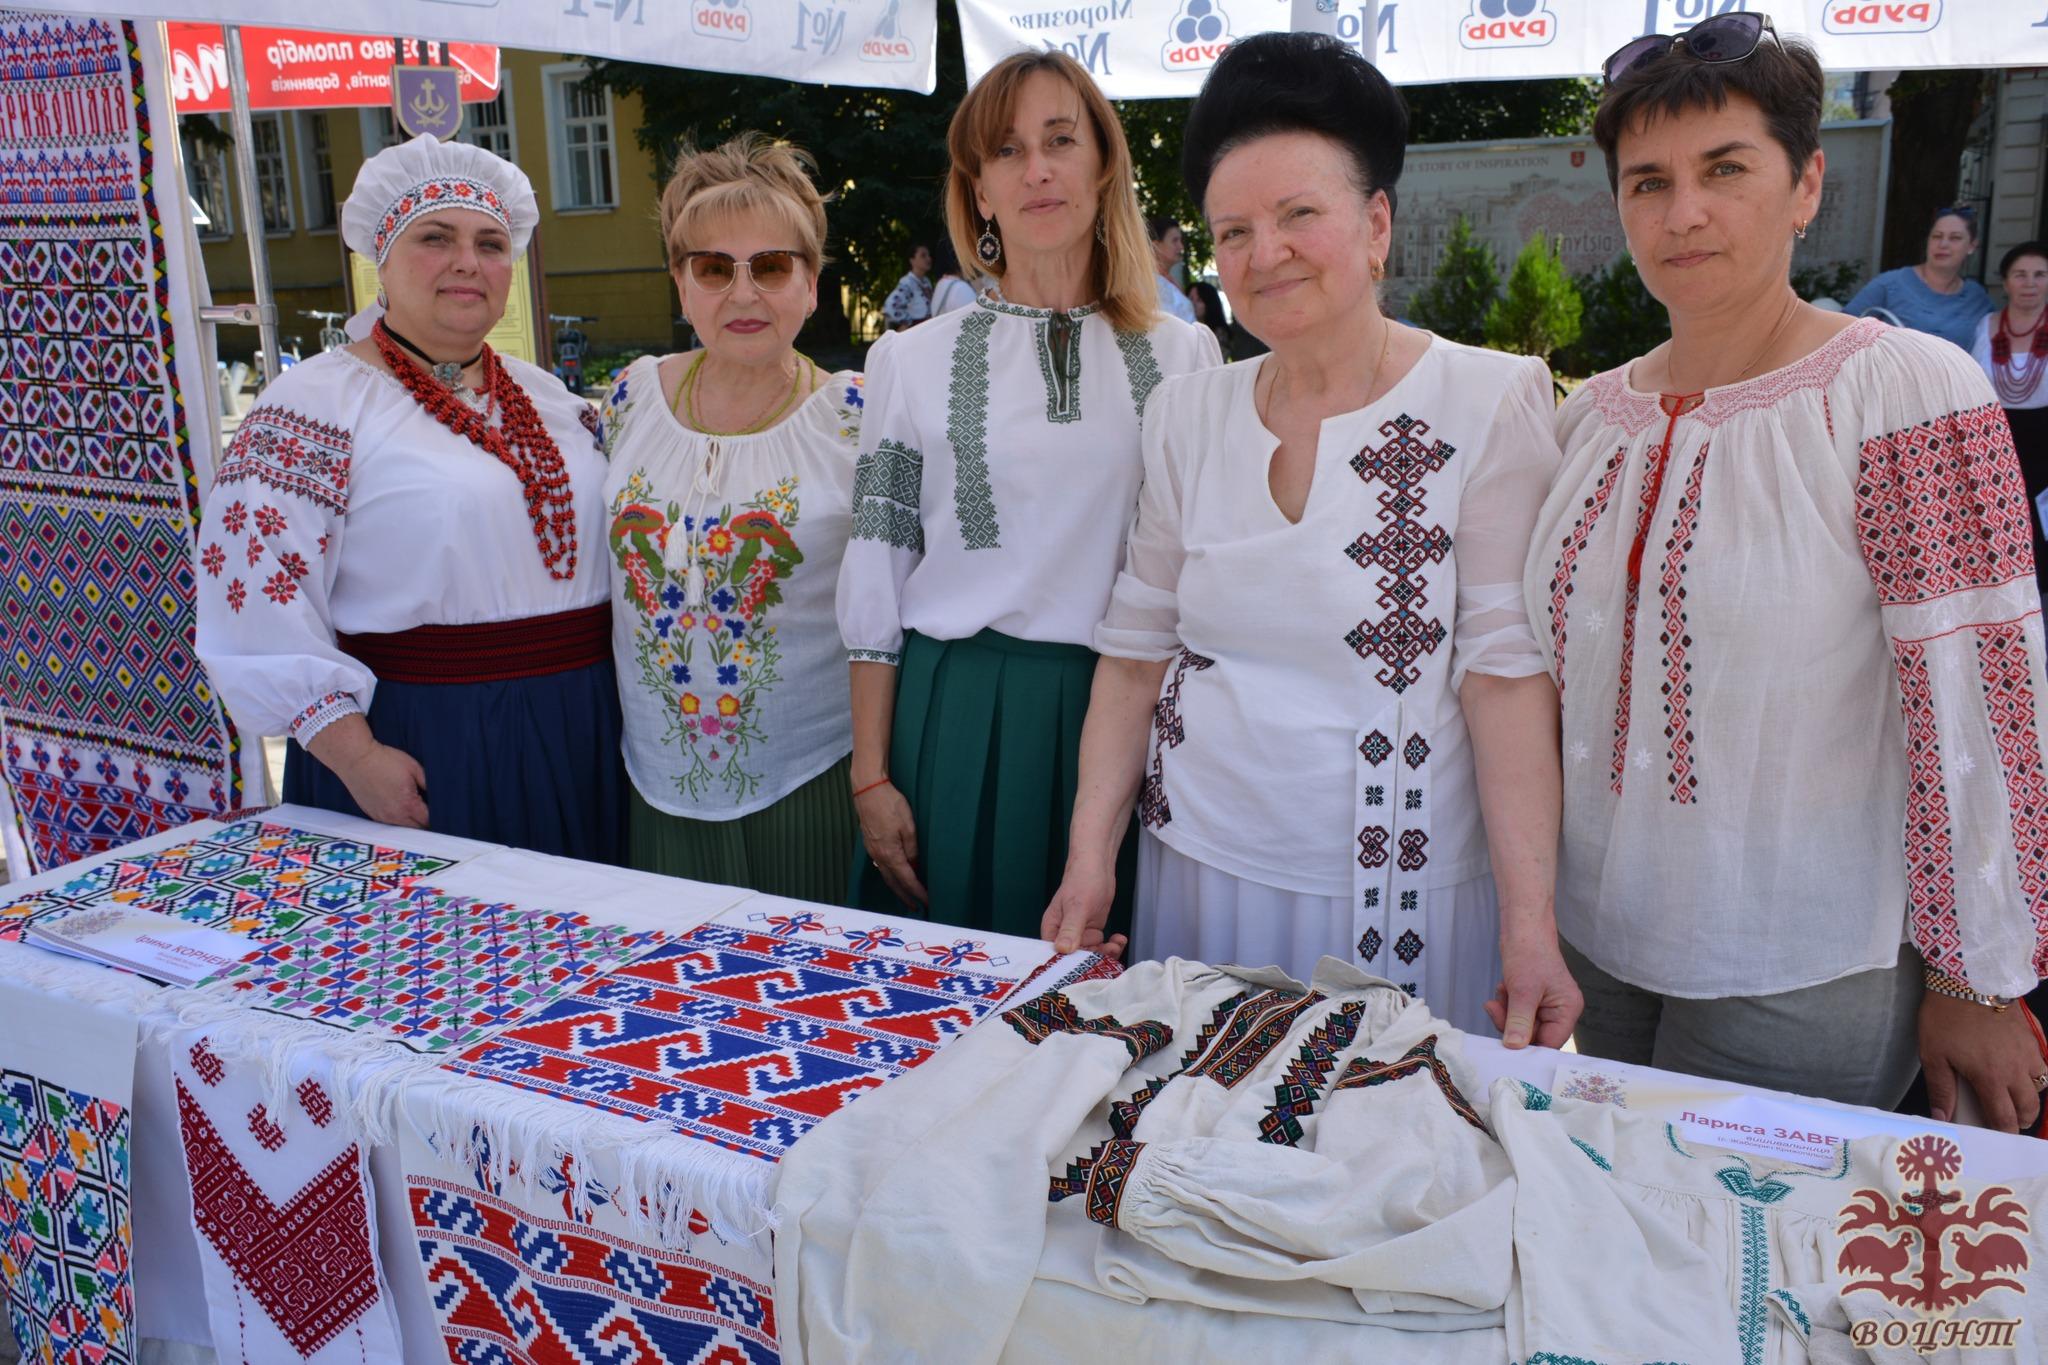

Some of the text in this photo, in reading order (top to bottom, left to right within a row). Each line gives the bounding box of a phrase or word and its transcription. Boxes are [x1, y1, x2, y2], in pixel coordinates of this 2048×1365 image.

[1456, 159, 1471, 171] OF
[1475, 156, 1550, 170] INSPIRATION
[1680, 1111, 1849, 1146] Лариса ЗАВЕ
